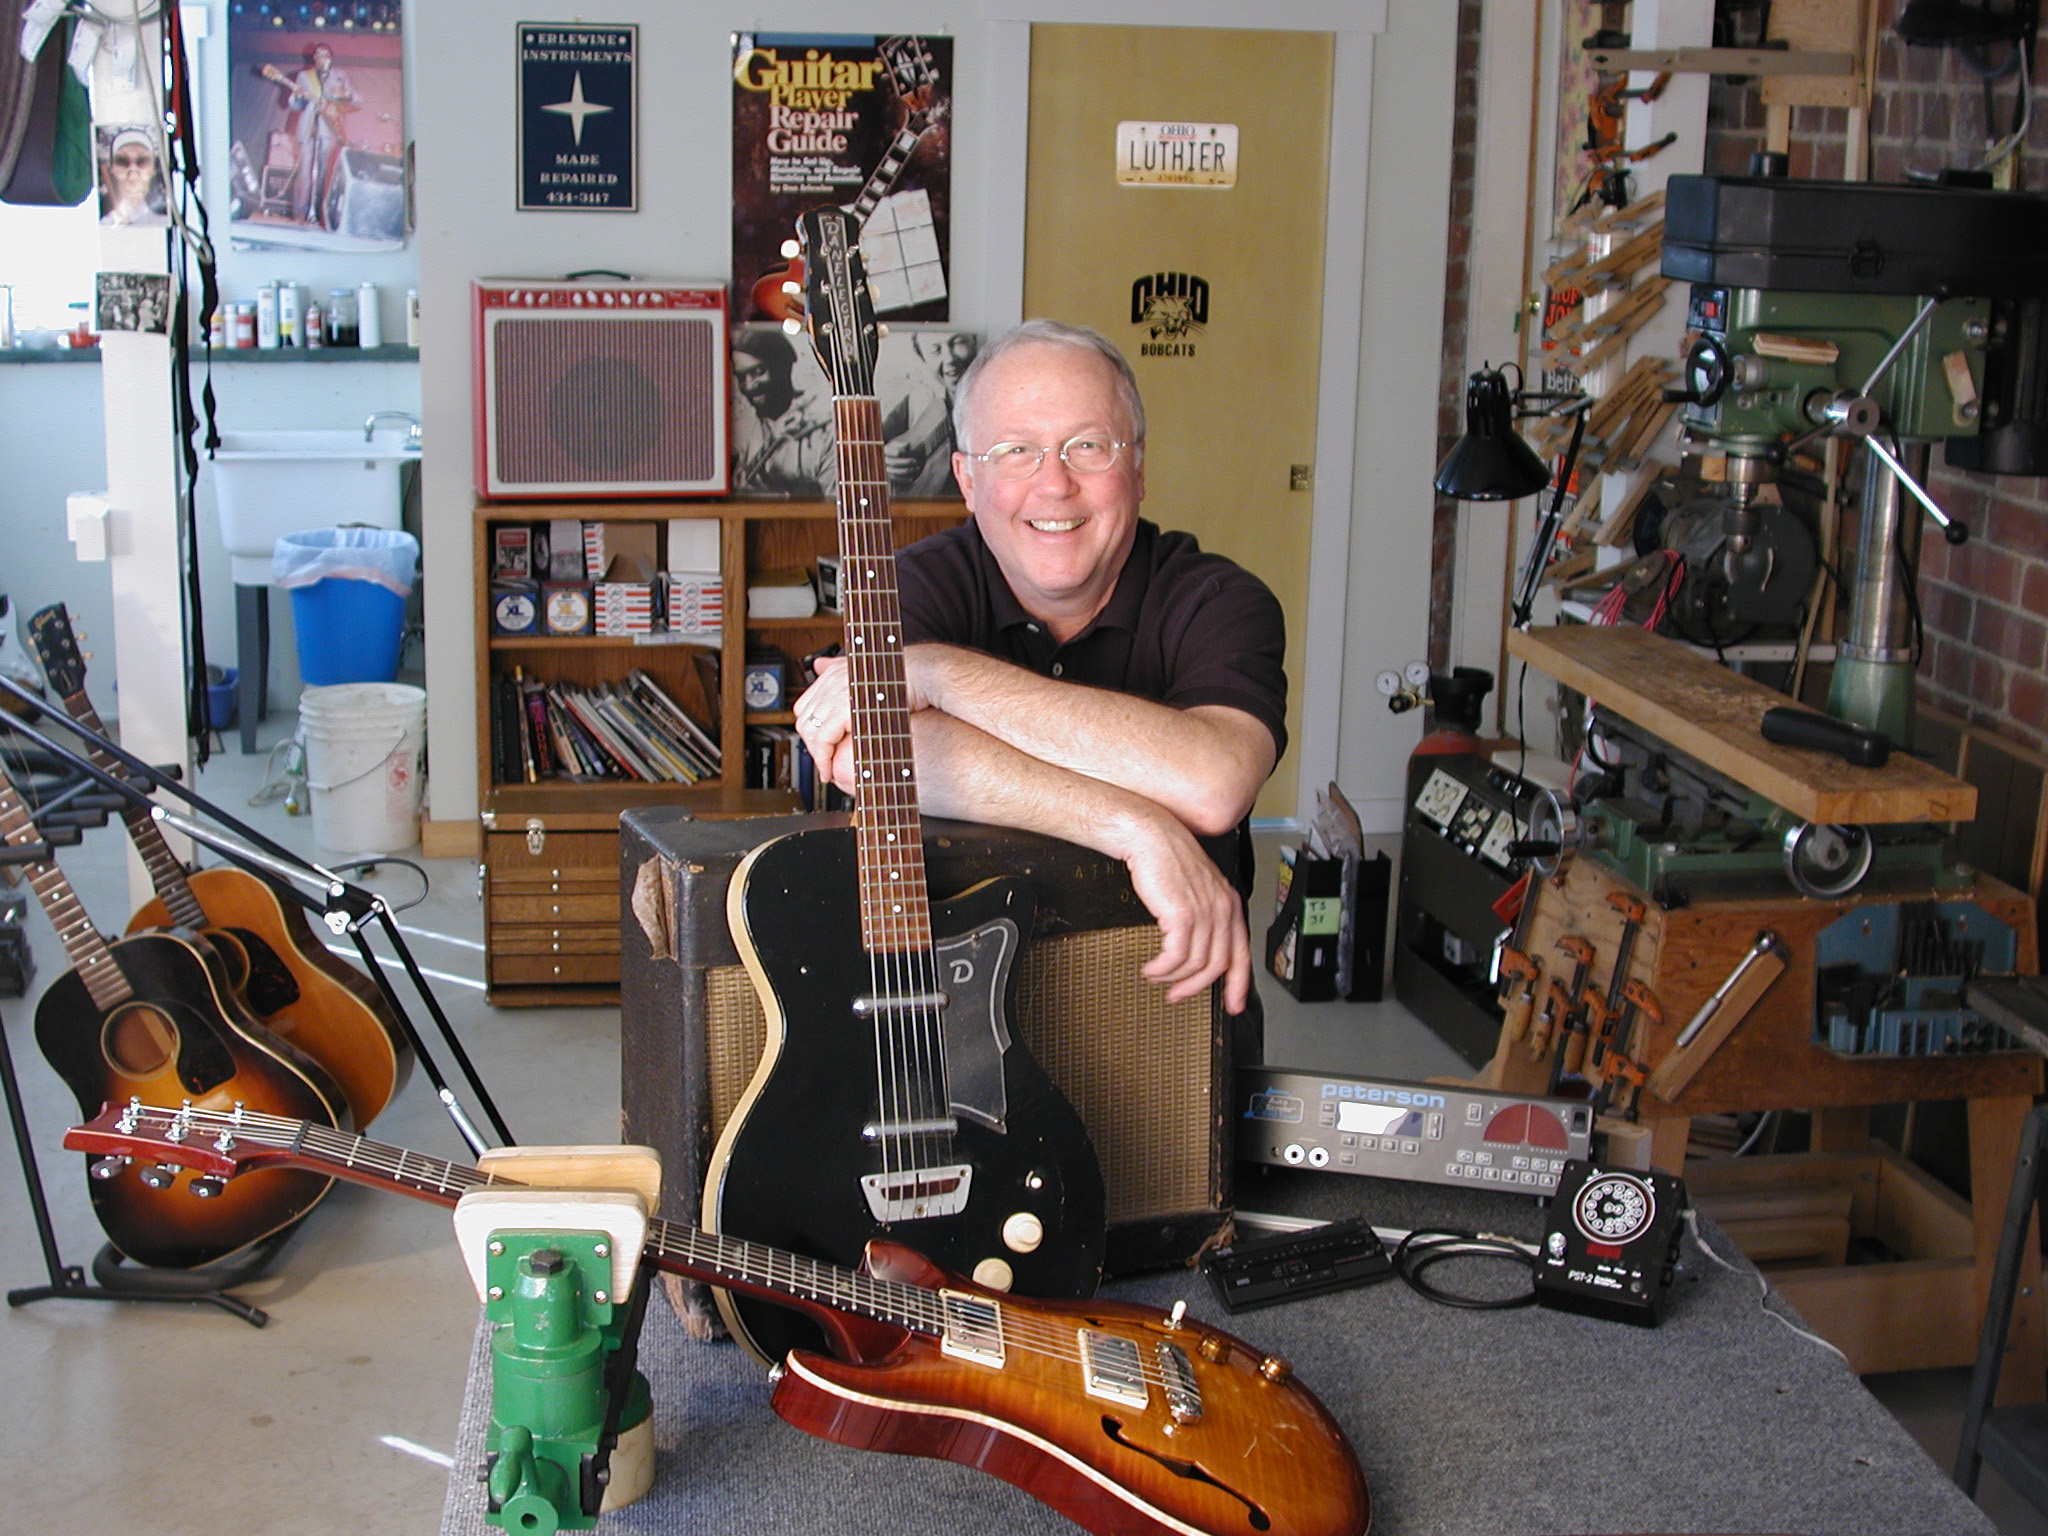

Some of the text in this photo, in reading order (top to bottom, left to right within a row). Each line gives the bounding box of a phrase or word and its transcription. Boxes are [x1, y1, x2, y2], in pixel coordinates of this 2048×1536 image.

[538, 33, 617, 45] ERLEWINE
[523, 49, 632, 62] INSTRUMENTS
[734, 48, 884, 92] Guitar
[769, 84, 853, 112] Player
[769, 105, 859, 135] Repair
[1161, 125, 1196, 136] OHIO
[766, 128, 849, 153] Guide
[555, 154, 599, 165] MADE
[1130, 140, 1225, 172] LUTHIER
[540, 172, 618, 184] REPAIRED
[546, 192, 610, 203] 434-3117
[1131, 272, 1209, 324] OHIO
[1141, 343, 1196, 357] BOBCATS
[1075, 861, 1128, 879] ATH
[1321, 1083, 1446, 1108] peterson
